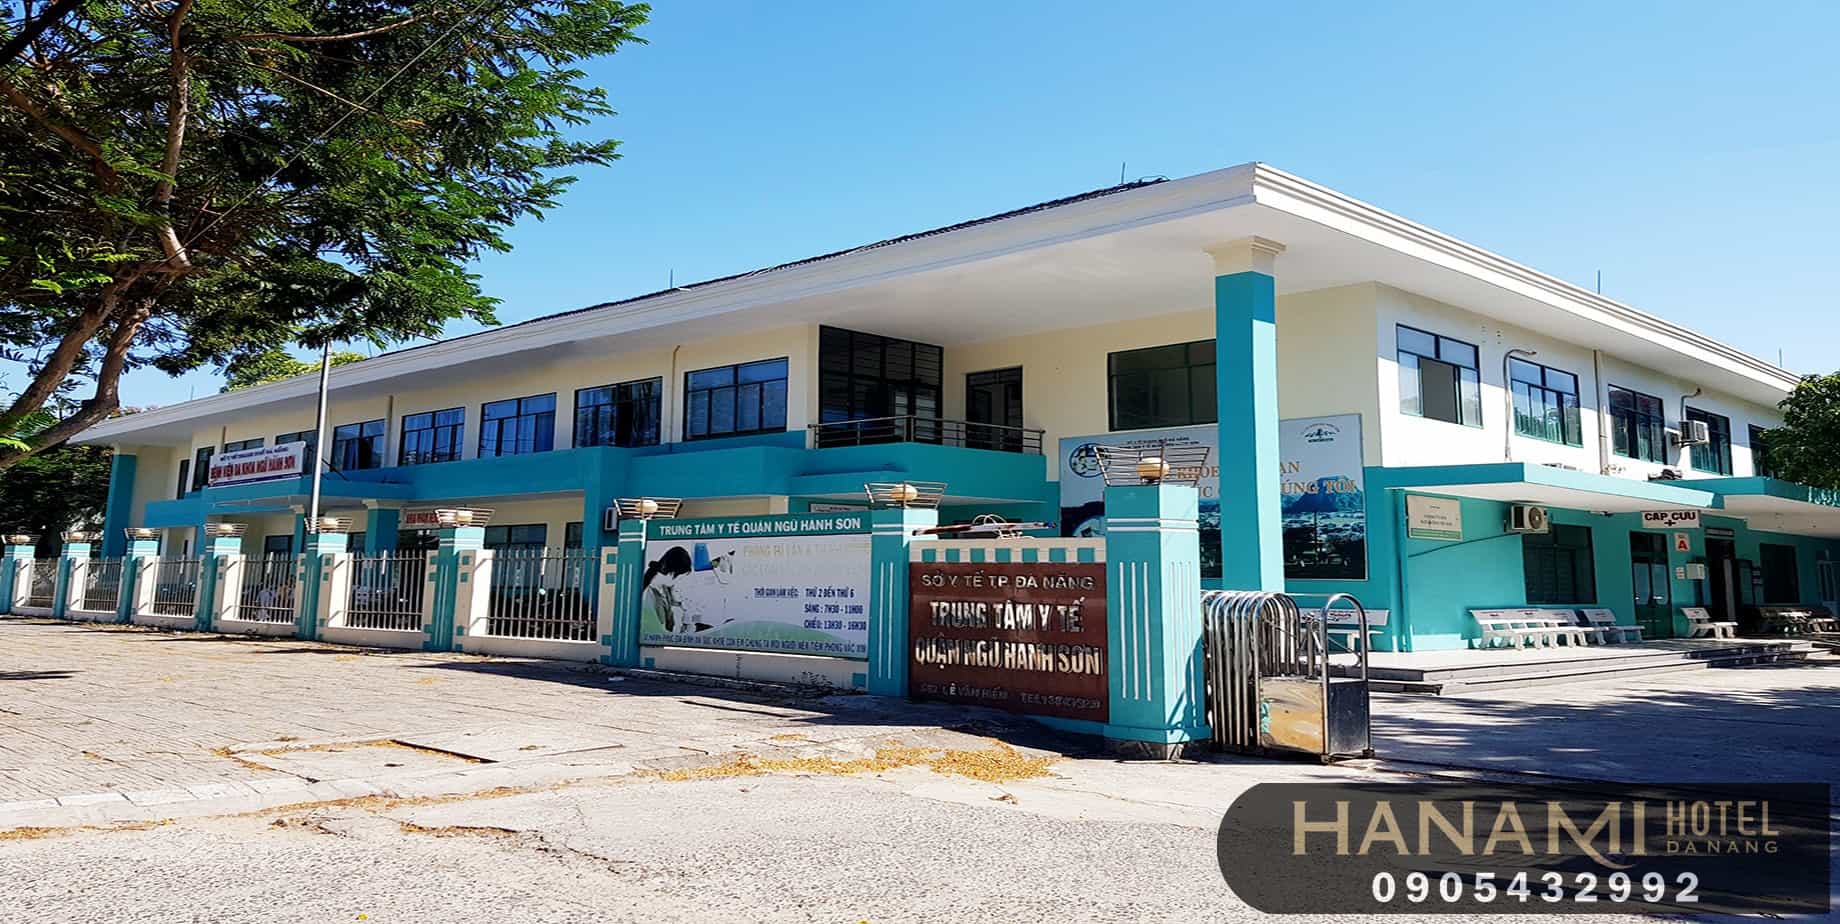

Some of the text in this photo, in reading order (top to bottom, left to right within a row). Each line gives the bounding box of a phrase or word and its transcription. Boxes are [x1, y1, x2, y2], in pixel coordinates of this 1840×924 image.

[659, 525, 692, 536] TRUNG
[718, 523, 725, 534] Y
[1678, 540, 1688, 550] A
[922, 570, 945, 587] SỞ
[948, 575, 958, 588] Y
[963, 570, 985, 588] TẾ
[929, 596, 1085, 632] TRUNG TÂM Y TẾ
[915, 632, 960, 670] QUẬN
[964, 636, 1000, 668] NGŨ
